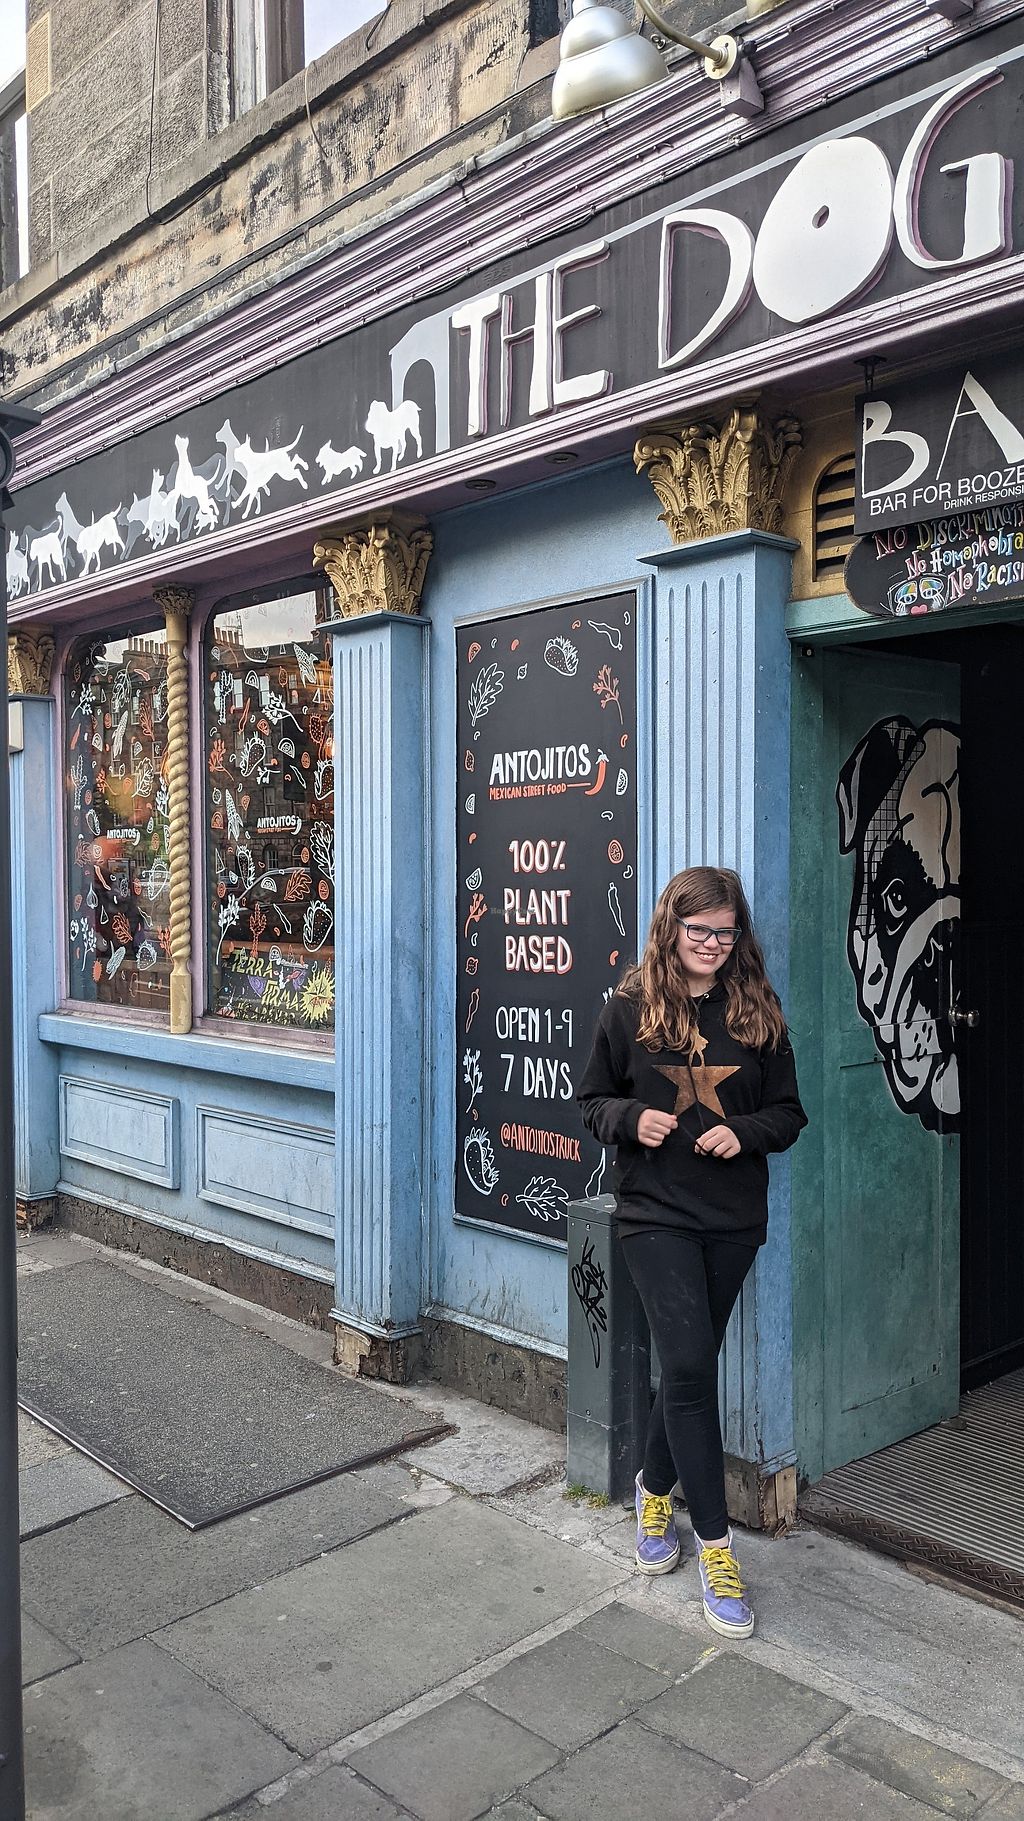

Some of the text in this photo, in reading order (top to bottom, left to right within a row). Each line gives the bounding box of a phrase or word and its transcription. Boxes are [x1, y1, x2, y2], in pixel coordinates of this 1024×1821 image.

[452, 66, 1010, 437] THE DOG
[870, 492, 906, 516] BAR
[912, 482, 951, 507] FOR
[944, 496, 972, 510] DRINK
[872, 526, 907, 561] NO
[975, 561, 1024, 593] Racis
[489, 743, 592, 786] ANTOJITOS
[489, 781, 567, 801] MEXICAN STREET FOOD
[106, 827, 137, 840] ANTOJITOS
[256, 814, 296, 829] ANTOJITOS
[508, 838, 567, 874] 100%
[503, 887, 571, 926] PLANT
[231, 949, 273, 979] TERRA
[505, 934, 573, 976] BASED
[495, 1006, 574, 1048] OPEN 1-9
[500, 1053, 574, 1101] 7 DAYS
[500, 1122, 582, 1163] @ANTOJITOSTRUCK
